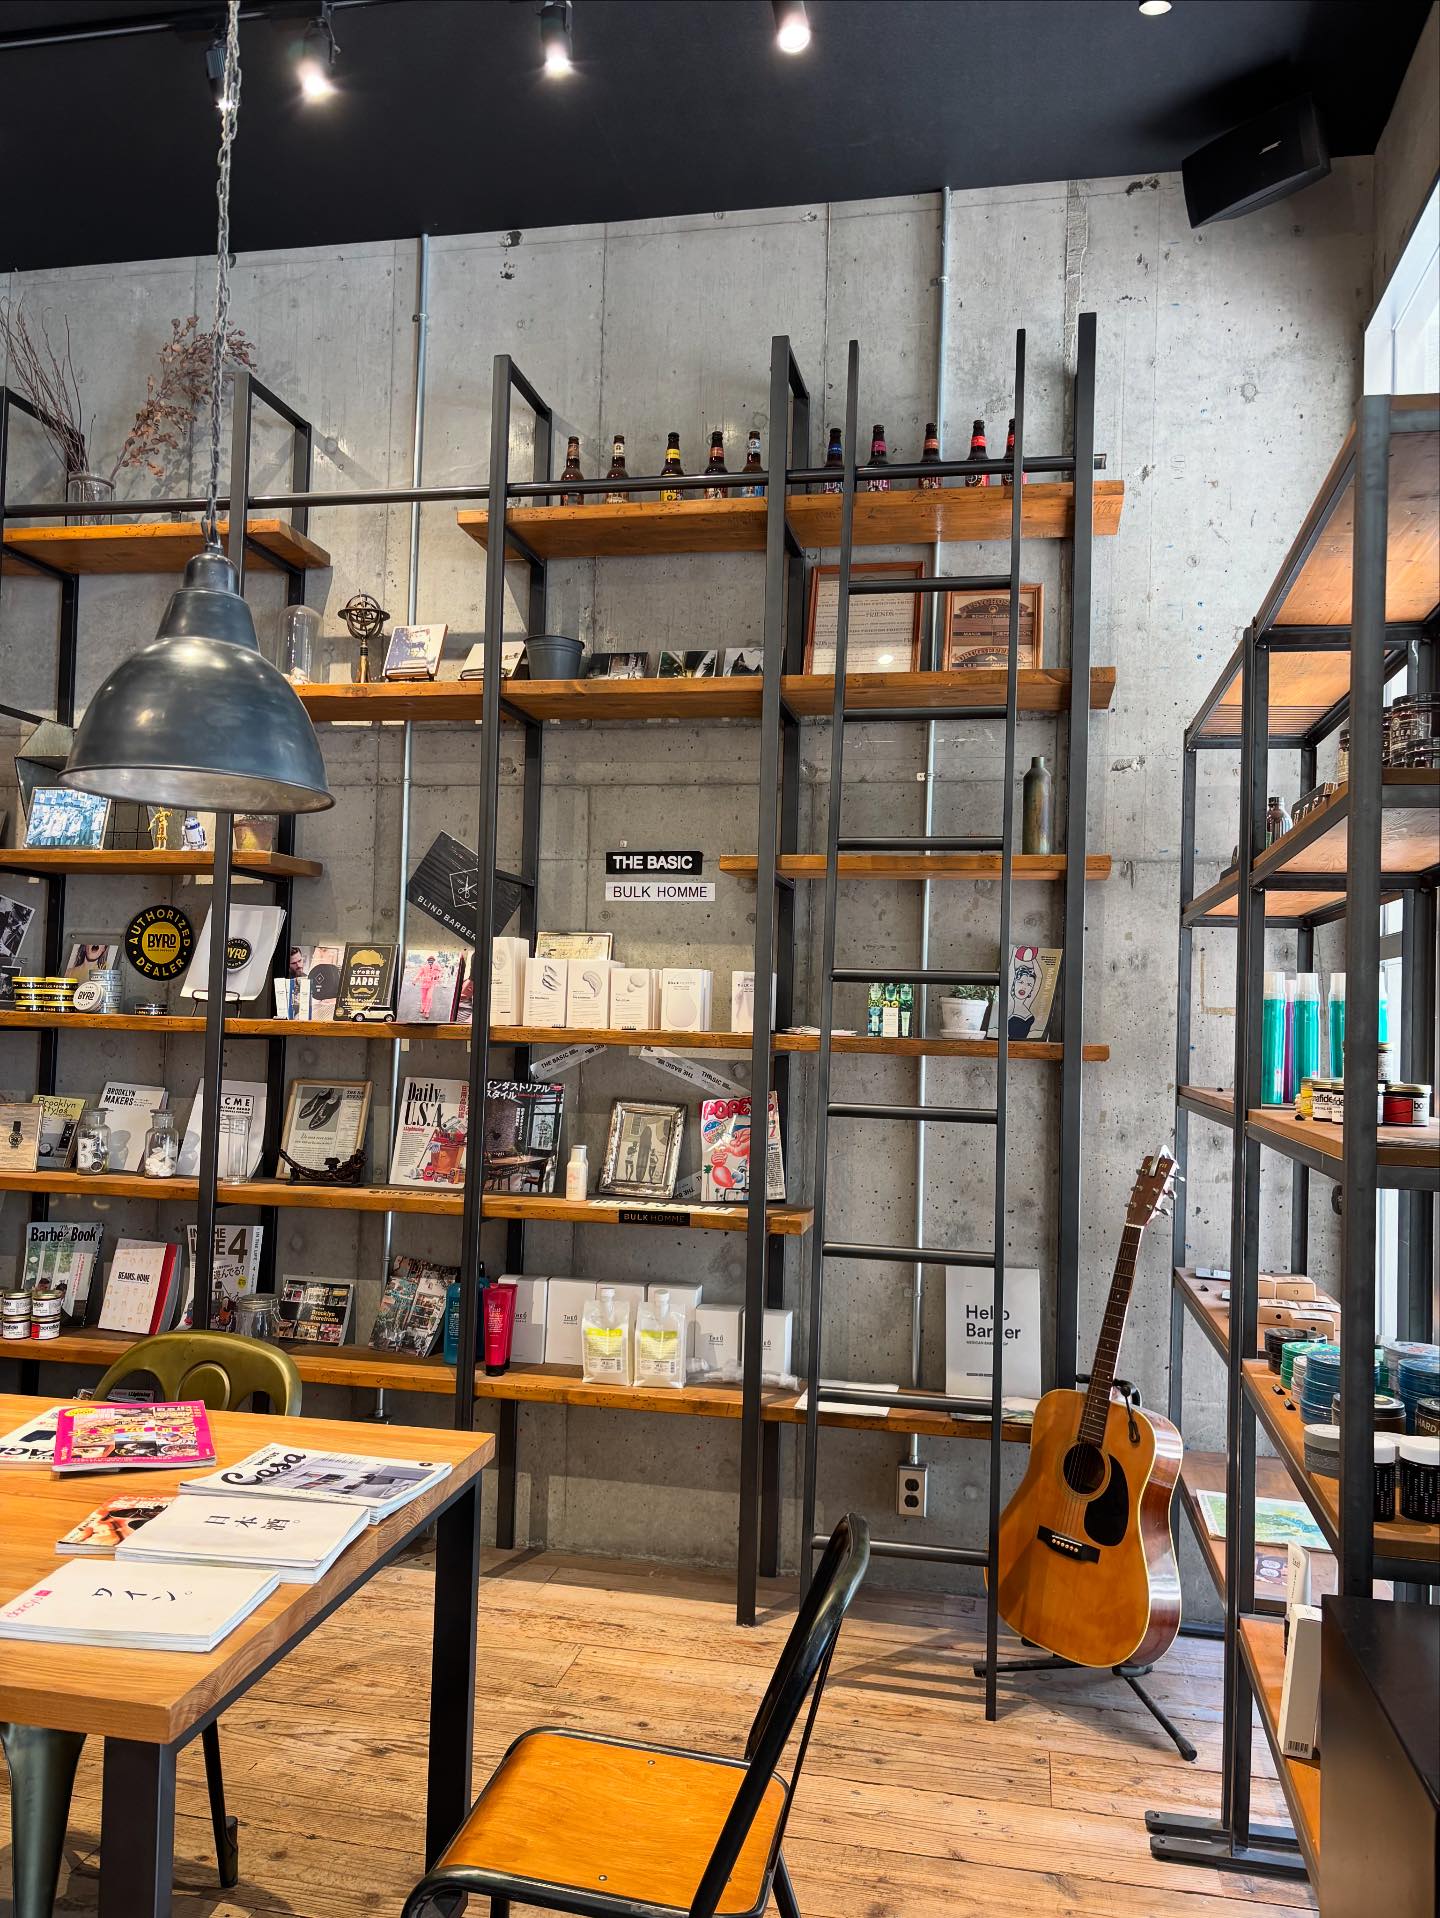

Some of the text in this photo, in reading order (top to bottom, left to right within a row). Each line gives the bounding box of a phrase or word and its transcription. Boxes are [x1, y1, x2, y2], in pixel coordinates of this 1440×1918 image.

[613, 855, 693, 870] THE BASIC
[613, 886, 708, 898] BULK HOMME
[417, 895, 443, 916] BLIND
[128, 908, 191, 947] AUTHORIZED
[147, 933, 177, 948] BYRD
[227, 946, 248, 960] YRD
[136, 956, 185, 977] DEALER
[350, 976, 380, 986] BARBE
[107, 1087, 136, 1097] BROOKLYN
[407, 1082, 442, 1103] Daily
[37, 1096, 76, 1109] Brooklyn
[103, 1094, 135, 1106] MAKERS
[623, 1213, 684, 1222] BULK HOMME
[71, 1226, 97, 1242] Book
[227, 1228, 249, 1264] 4
[966, 1304, 1010, 1321] Helo
[966, 1322, 1021, 1339] Barer
[220, 1452, 306, 1486] Casa
